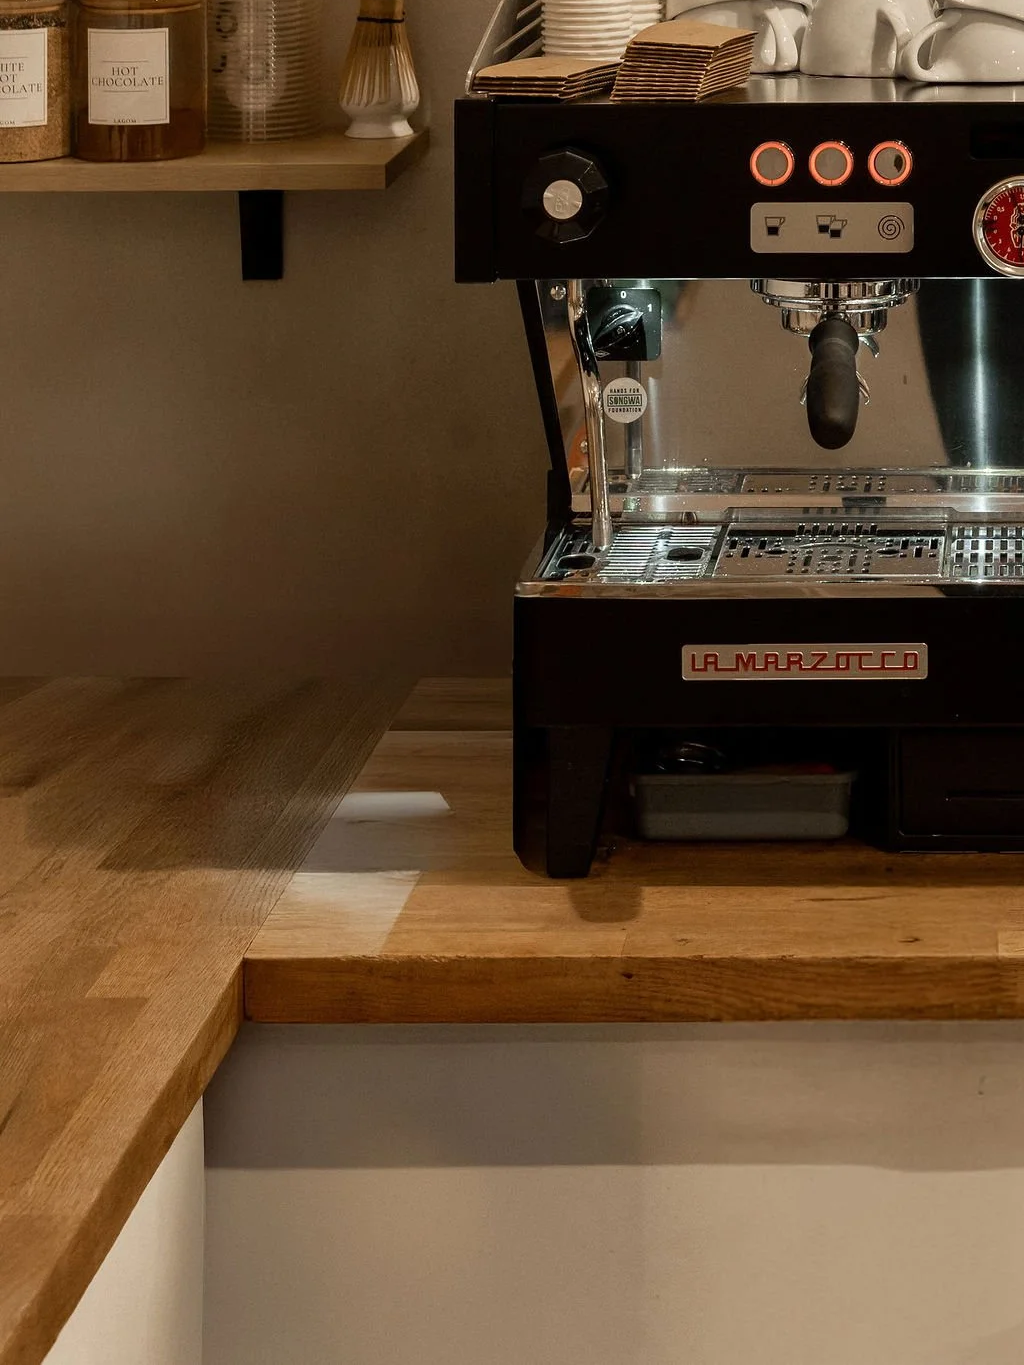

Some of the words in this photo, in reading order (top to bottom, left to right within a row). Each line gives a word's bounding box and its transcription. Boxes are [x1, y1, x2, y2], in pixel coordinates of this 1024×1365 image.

[111, 66, 138, 76] HOT
[0, 74, 17, 83] OT
[91, 76, 164, 87] CHOCOLATE
[620, 290, 627, 299] 0
[647, 303, 653, 312] 1
[609, 396, 641, 405] SONGWA
[691, 652, 719, 672] LA
[735, 651, 919, 672] MARZOCCO
